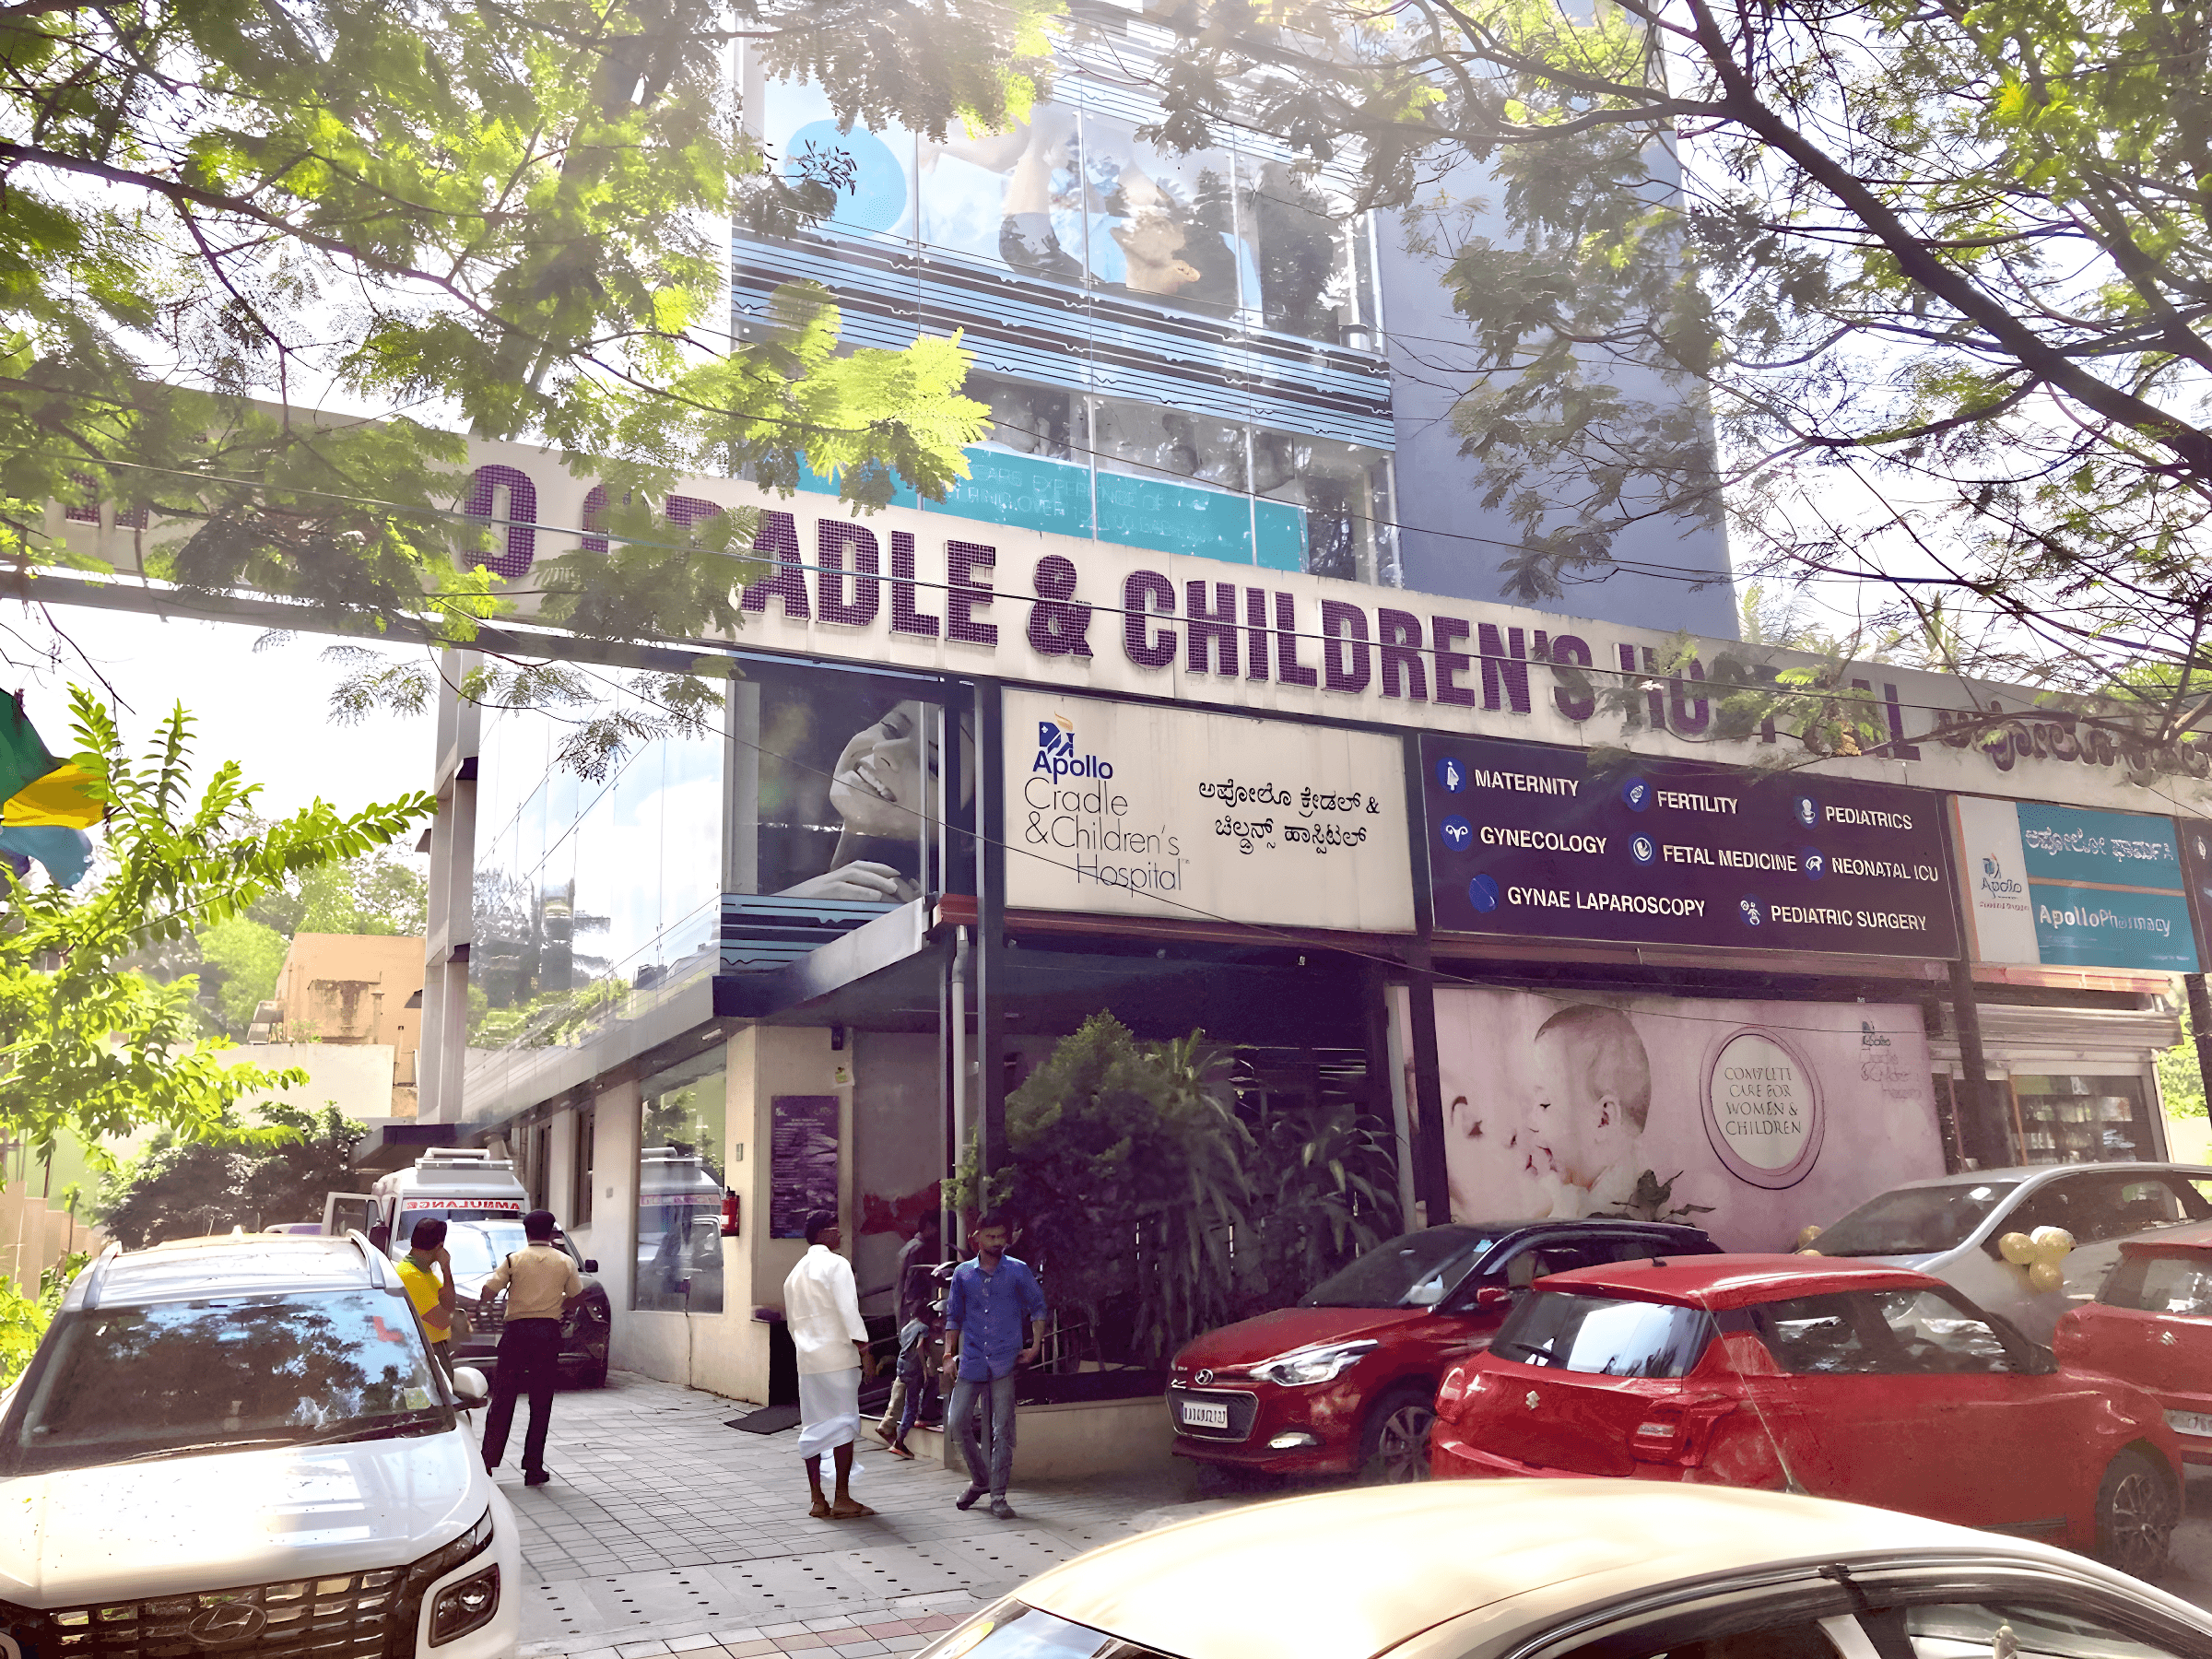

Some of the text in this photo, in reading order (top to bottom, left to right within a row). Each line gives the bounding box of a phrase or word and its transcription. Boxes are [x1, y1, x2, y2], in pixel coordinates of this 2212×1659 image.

[1025, 554, 1094, 658] &
[1122, 569, 1596, 724] CHILDREN'S
[1032, 750, 1113, 784] Apollo
[1475, 770, 1579, 796] MATERNITY
[1025, 777, 1128, 816] Cradle
[1366, 796, 1380, 814] &
[1657, 791, 1738, 814] FERTILITY
[1826, 806, 1912, 830] PEDIATRICS
[1480, 826, 1607, 853] GYNECOLOGY
[1663, 844, 1798, 872] FETAL MEDICINE
[1831, 857, 1939, 882] NEONATAL ICU
[1077, 853, 1181, 898] Hospital
[1508, 886, 1705, 917] GYNAE LAPAROSCOPY
[1771, 905, 1926, 931] PEDIATRIC SURGERY
[1725, 1101, 1798, 1116] WOMEN &
[1725, 1120, 1802, 1135] CHILDREN
